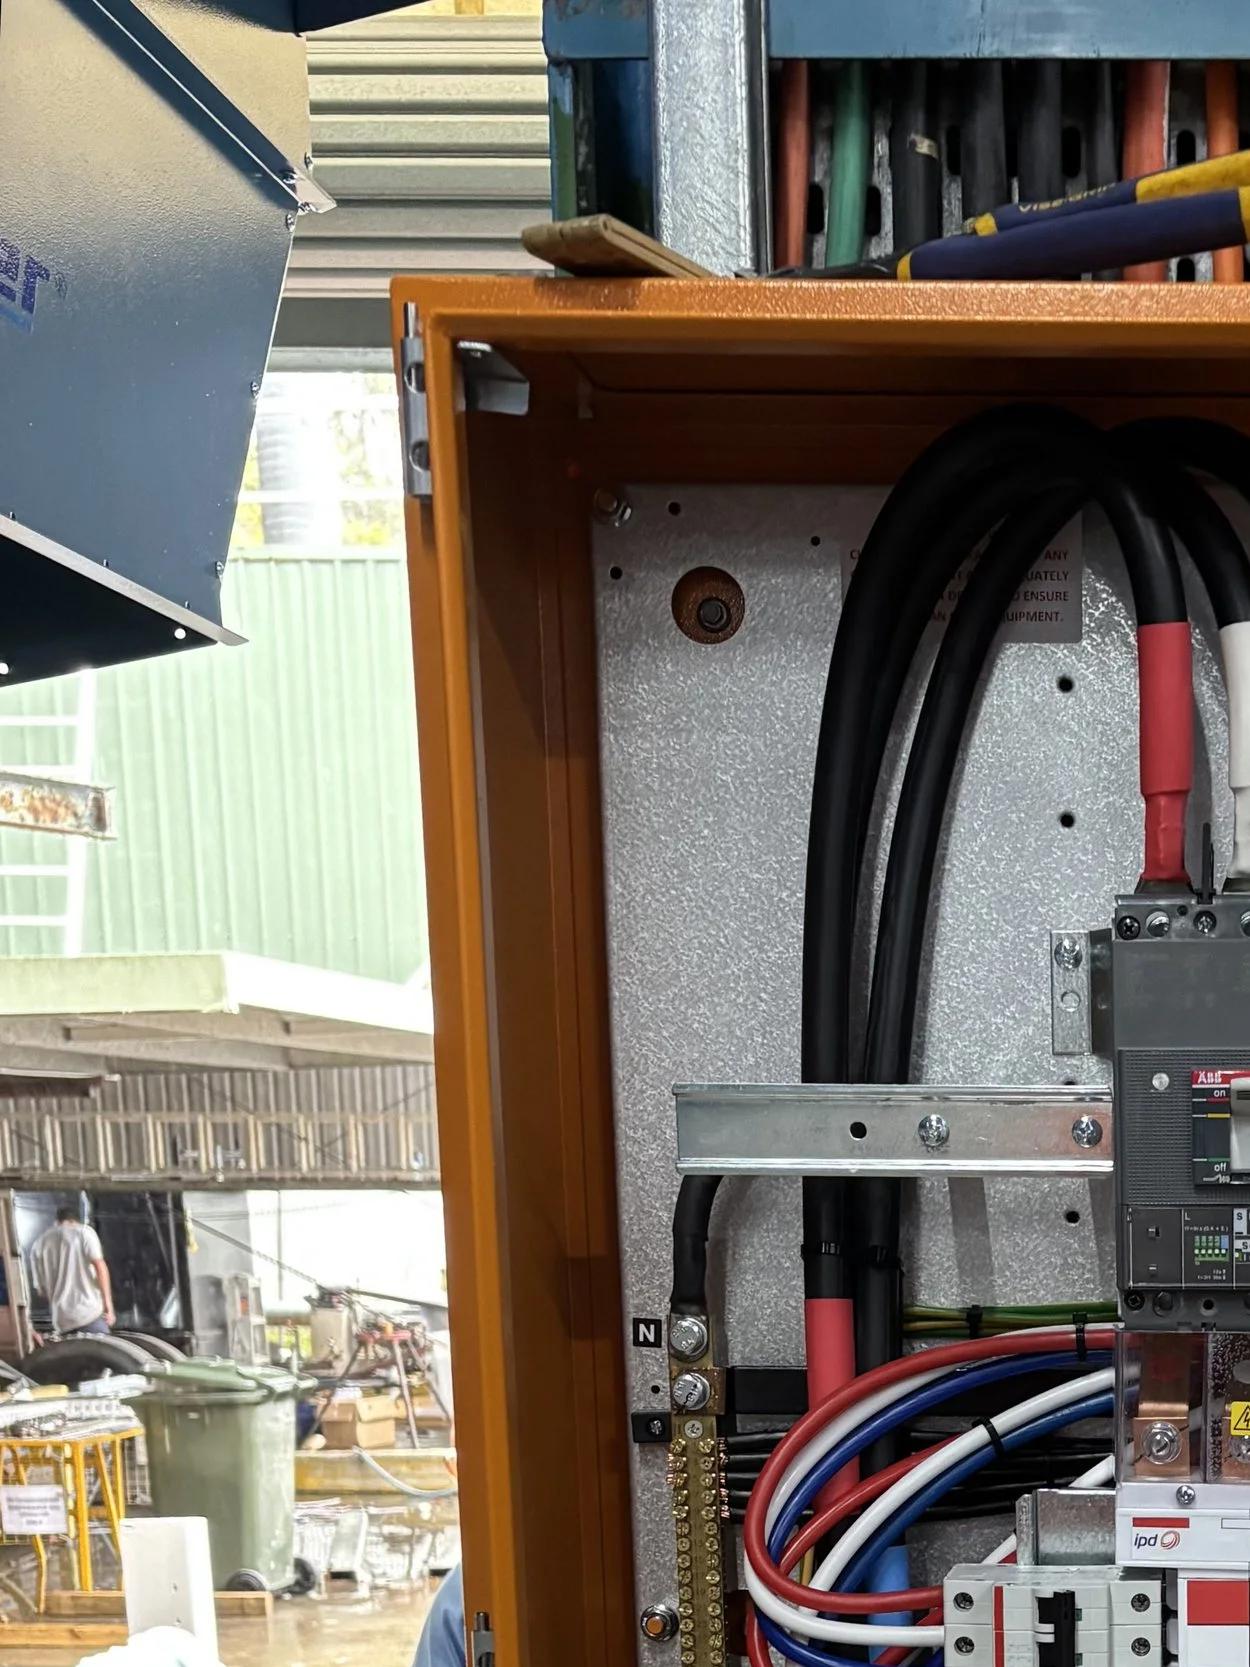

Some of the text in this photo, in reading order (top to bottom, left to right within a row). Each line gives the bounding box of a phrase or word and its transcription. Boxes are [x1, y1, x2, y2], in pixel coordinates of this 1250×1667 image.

[1044, 550, 1069, 561] ANY
[1023, 570, 1069, 581] UATELY
[1024, 591, 1069, 602] ENSURE
[1004, 611, 1064, 622] UIPMENT.
[1197, 1071, 1222, 1084] ABB
[1213, 1089, 1226, 1097] on
[1214, 1162, 1227, 1172] off
[1236, 1212, 1243, 1221] S
[1242, 1241, 1249, 1250] S
[638, 1323, 655, 1343] N
[1134, 1533, 1158, 1549] ipd
